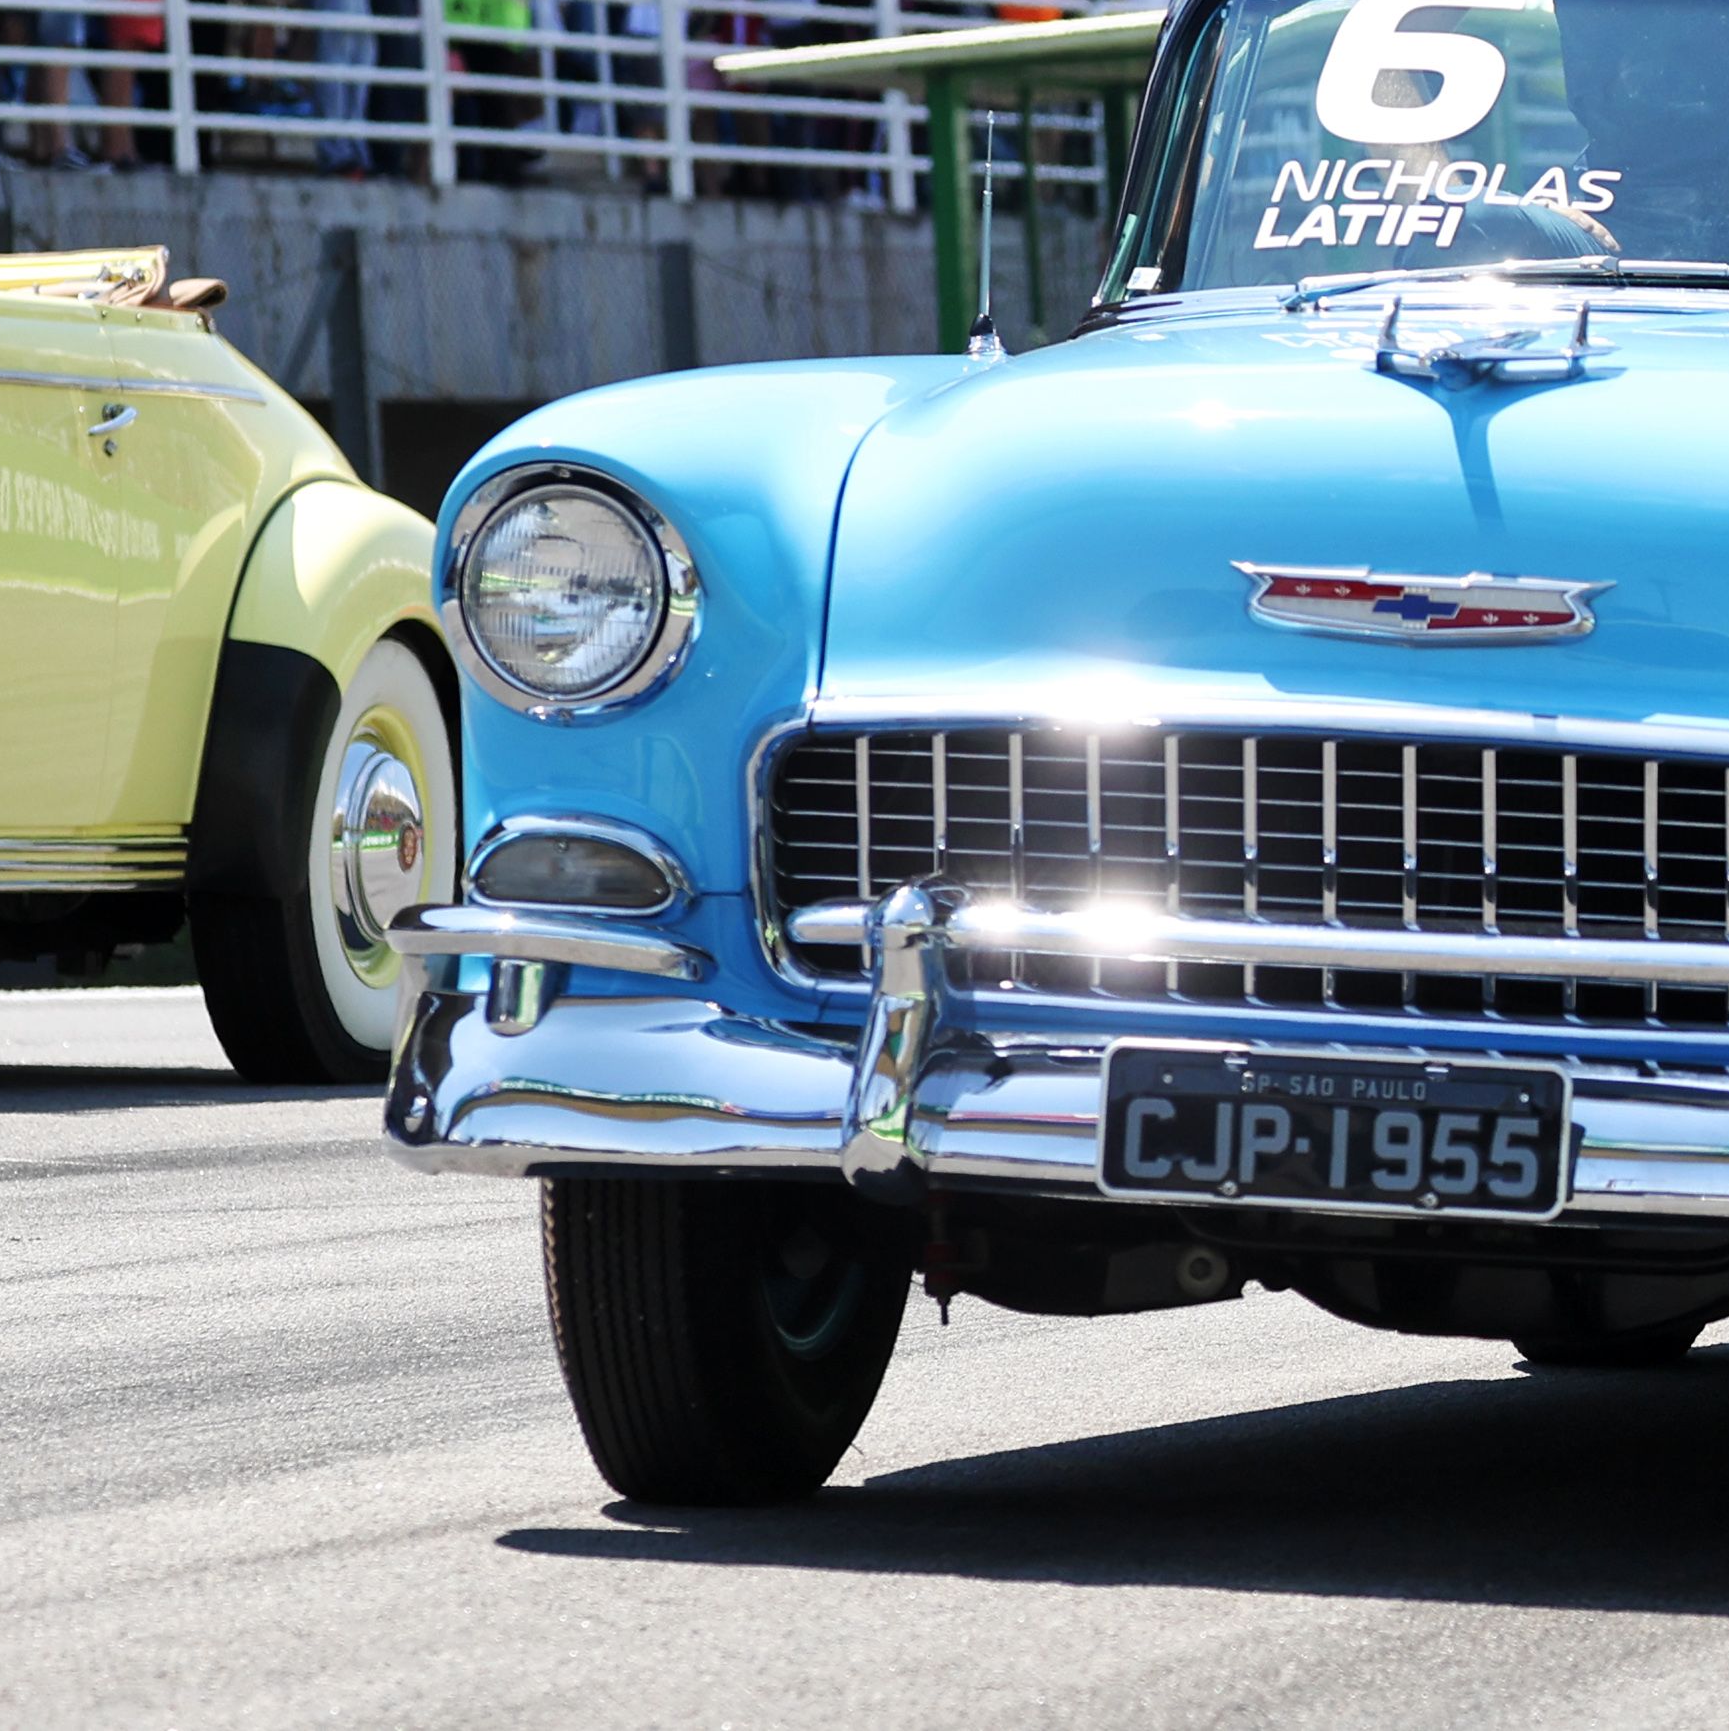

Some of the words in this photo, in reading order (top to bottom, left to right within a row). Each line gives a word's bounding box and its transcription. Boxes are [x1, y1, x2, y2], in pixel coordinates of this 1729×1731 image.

[1271, 159, 1622, 212] NICHOLAS
[1253, 204, 1464, 249] LATIFI
[1351, 1078, 1427, 1101] PAULO
